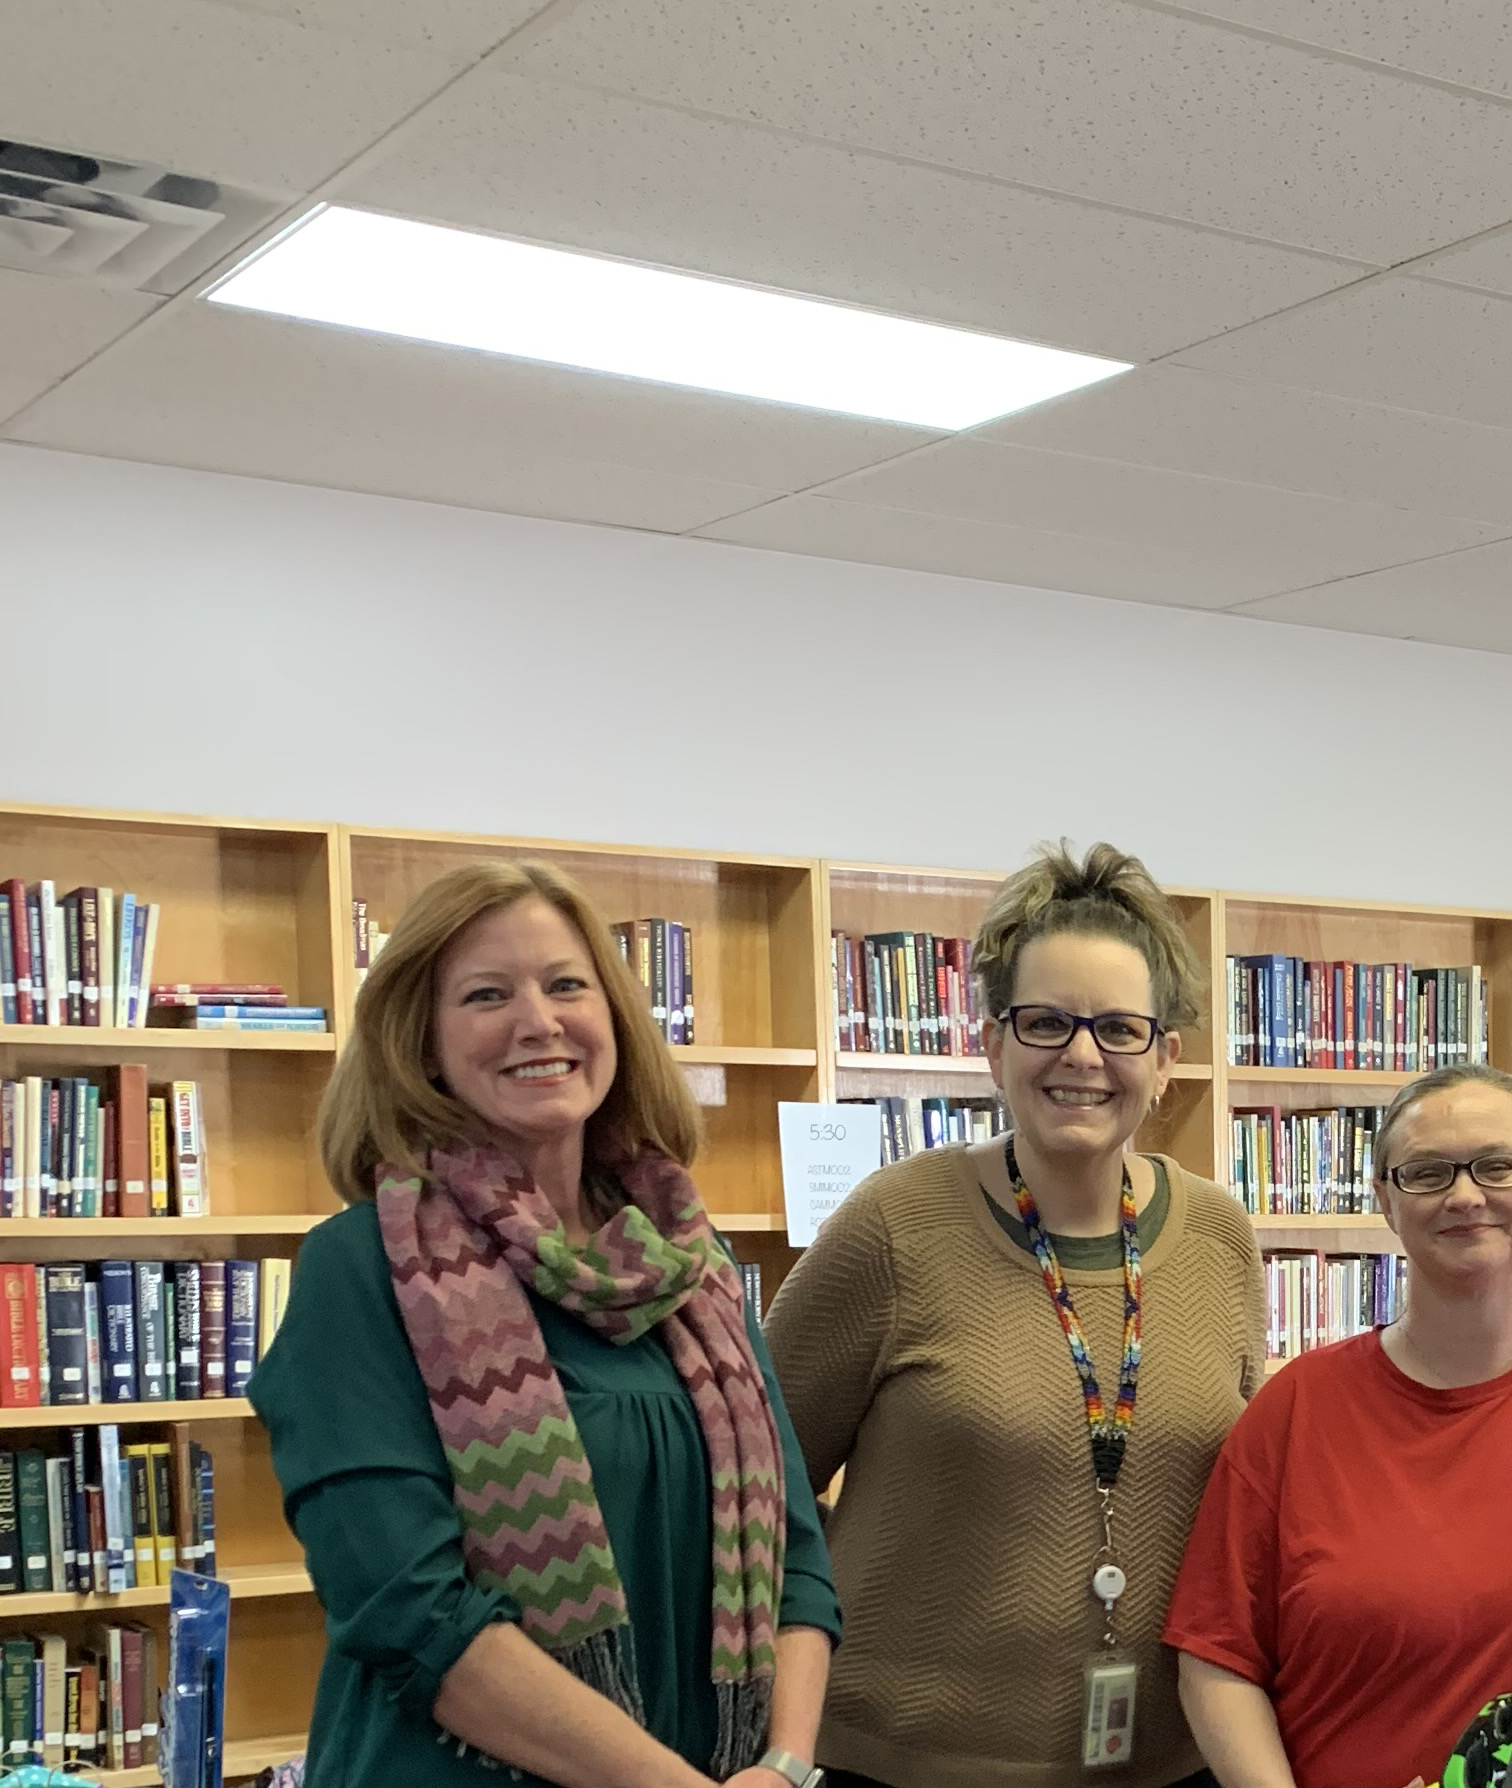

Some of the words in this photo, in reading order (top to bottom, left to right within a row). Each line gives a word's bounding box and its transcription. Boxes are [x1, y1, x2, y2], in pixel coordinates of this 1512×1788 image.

[809, 1123, 847, 1141] 5:30
[10, 1300, 24, 1332] BIBLE
[11, 1334, 28, 1400] DICTIARY
